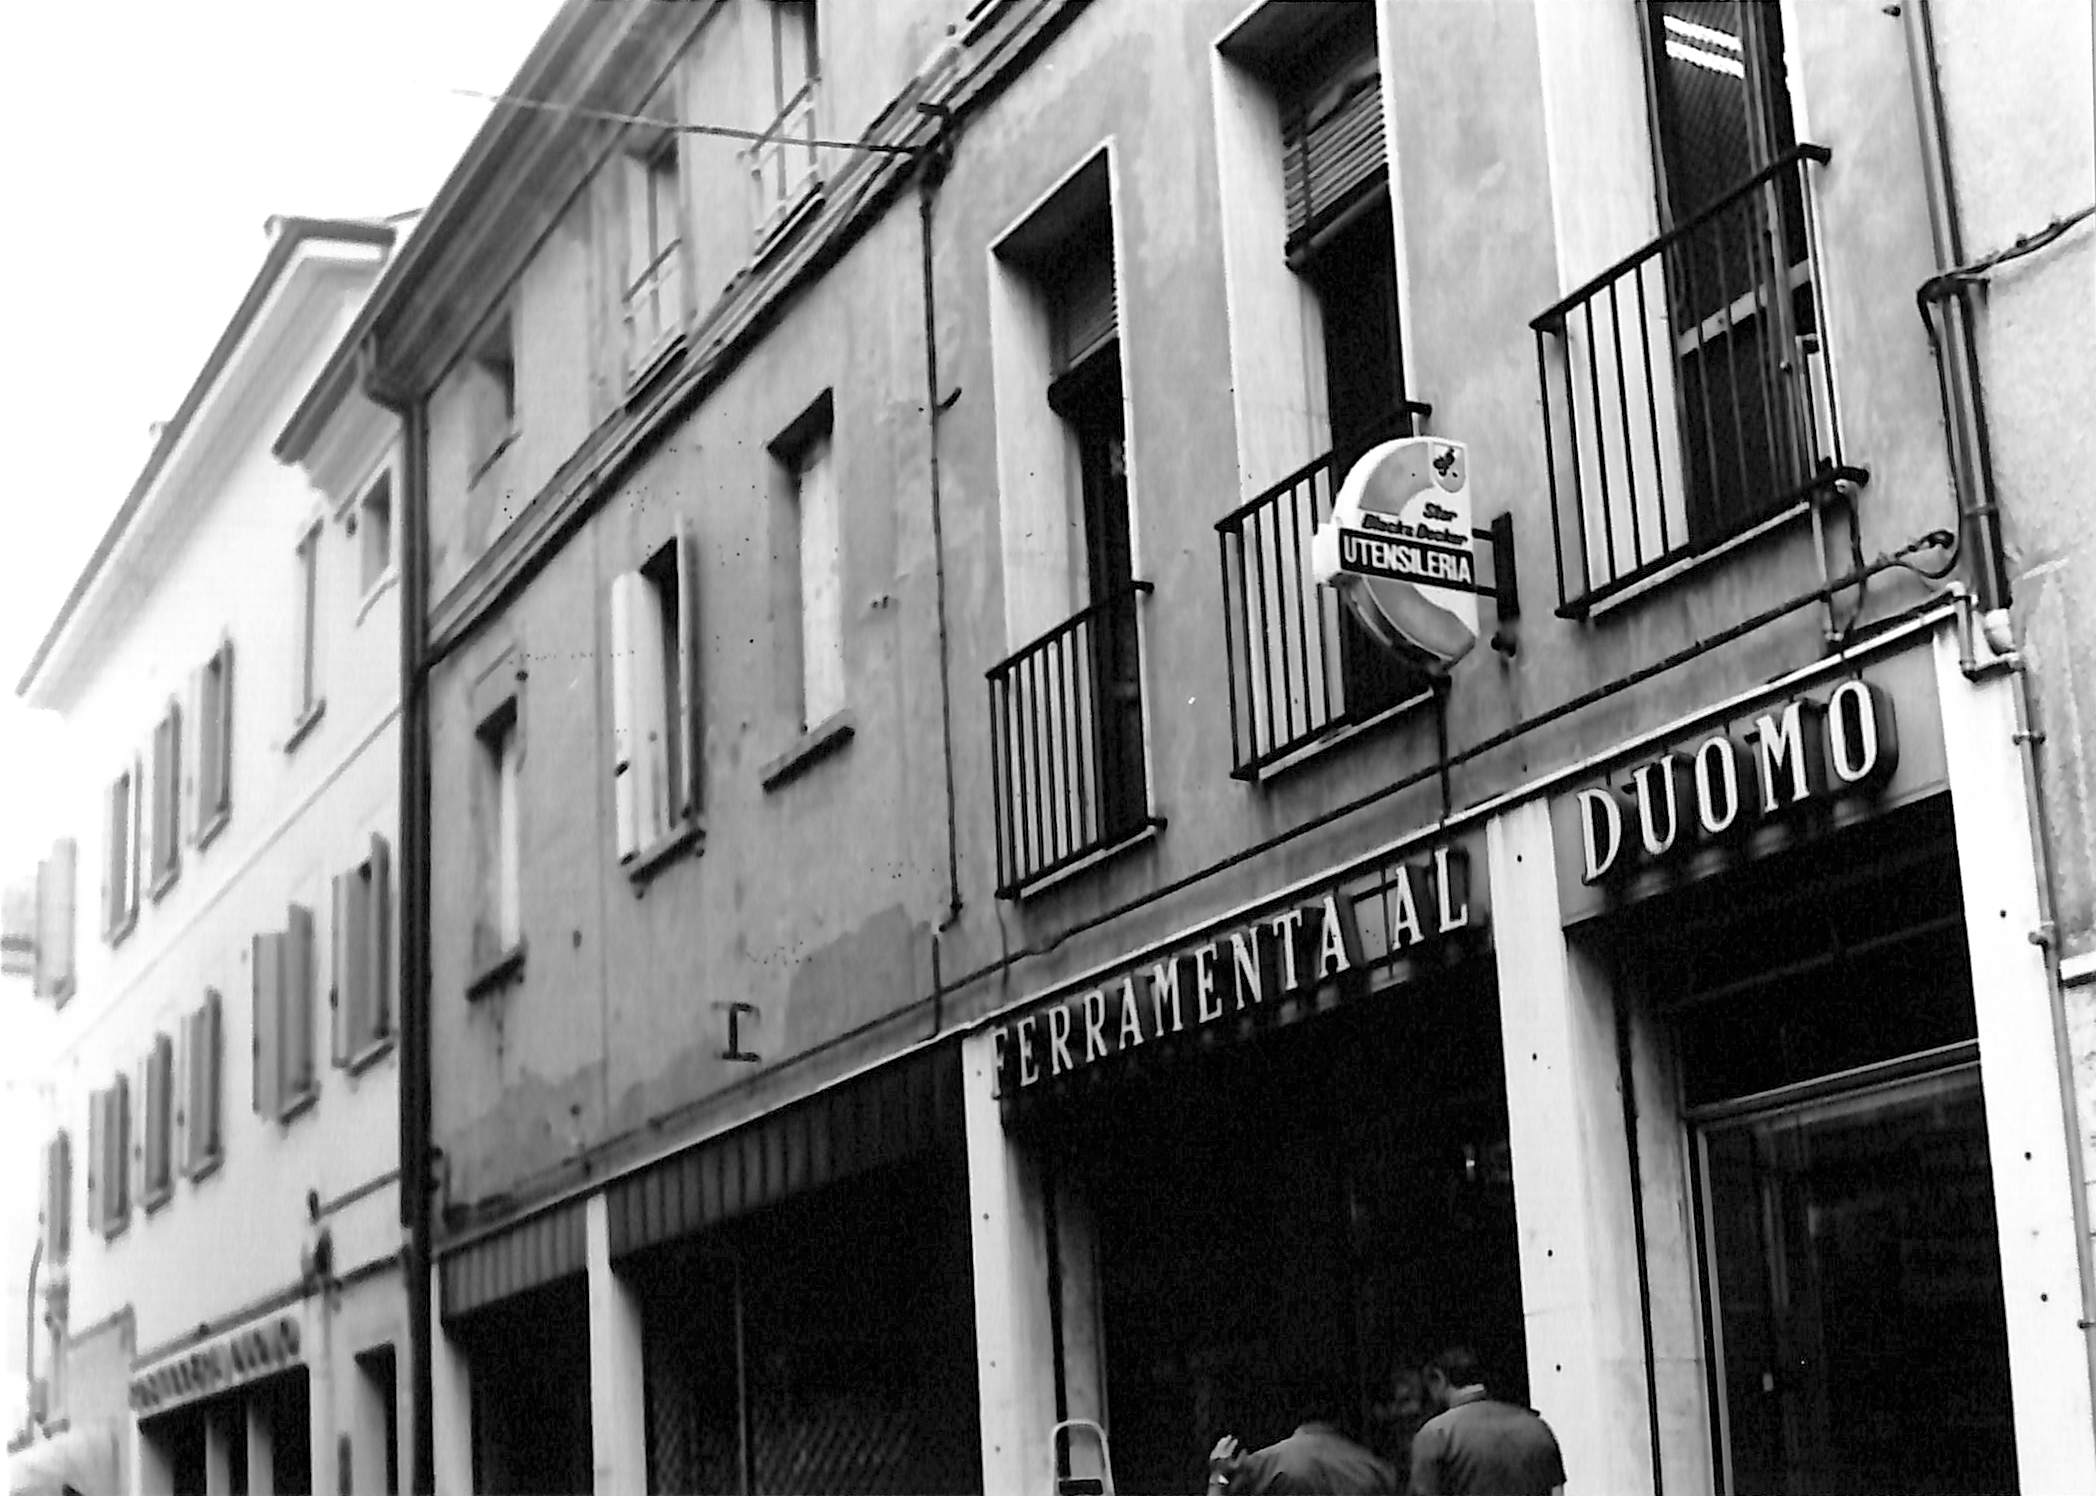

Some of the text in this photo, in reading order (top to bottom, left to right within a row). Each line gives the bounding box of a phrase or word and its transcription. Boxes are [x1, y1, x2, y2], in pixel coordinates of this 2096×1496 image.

[1343, 534, 1473, 585] UTENSILERIA
[990, 679, 1878, 1099] FERRAMENTA AL DUOMO
